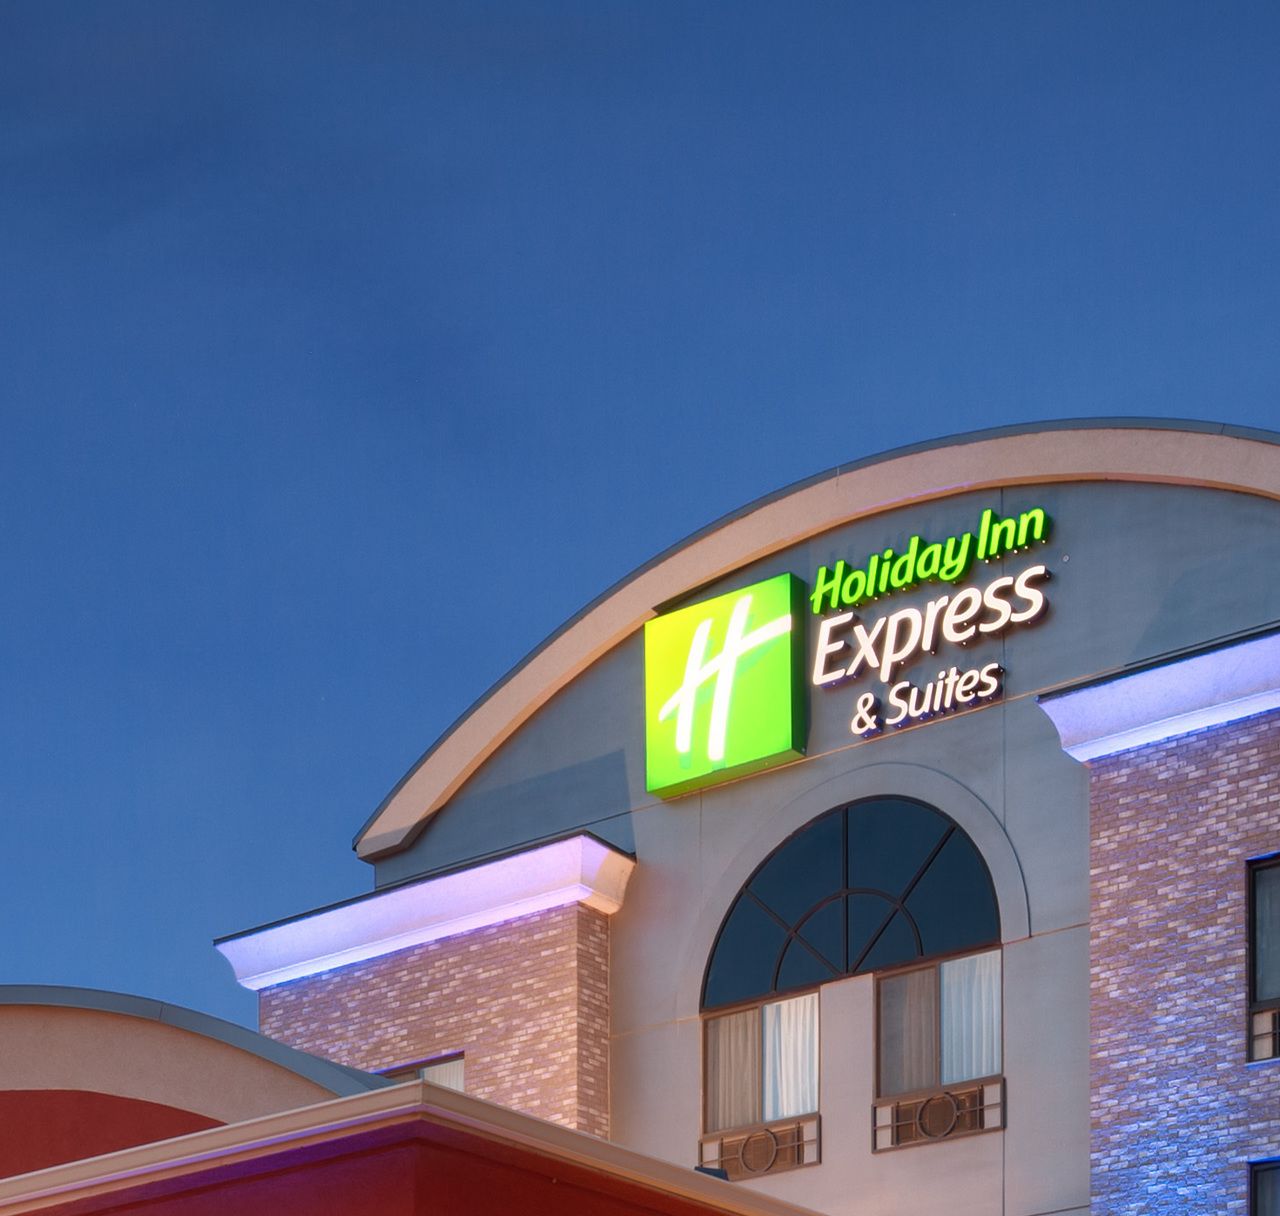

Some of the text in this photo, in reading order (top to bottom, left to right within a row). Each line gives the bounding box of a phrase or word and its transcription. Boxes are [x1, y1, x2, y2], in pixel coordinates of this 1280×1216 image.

[810, 507, 1048, 615] Holiday Inn
[658, 594, 792, 761] H
[812, 565, 1047, 686] Express
[851, 662, 1000, 735] & Suites
